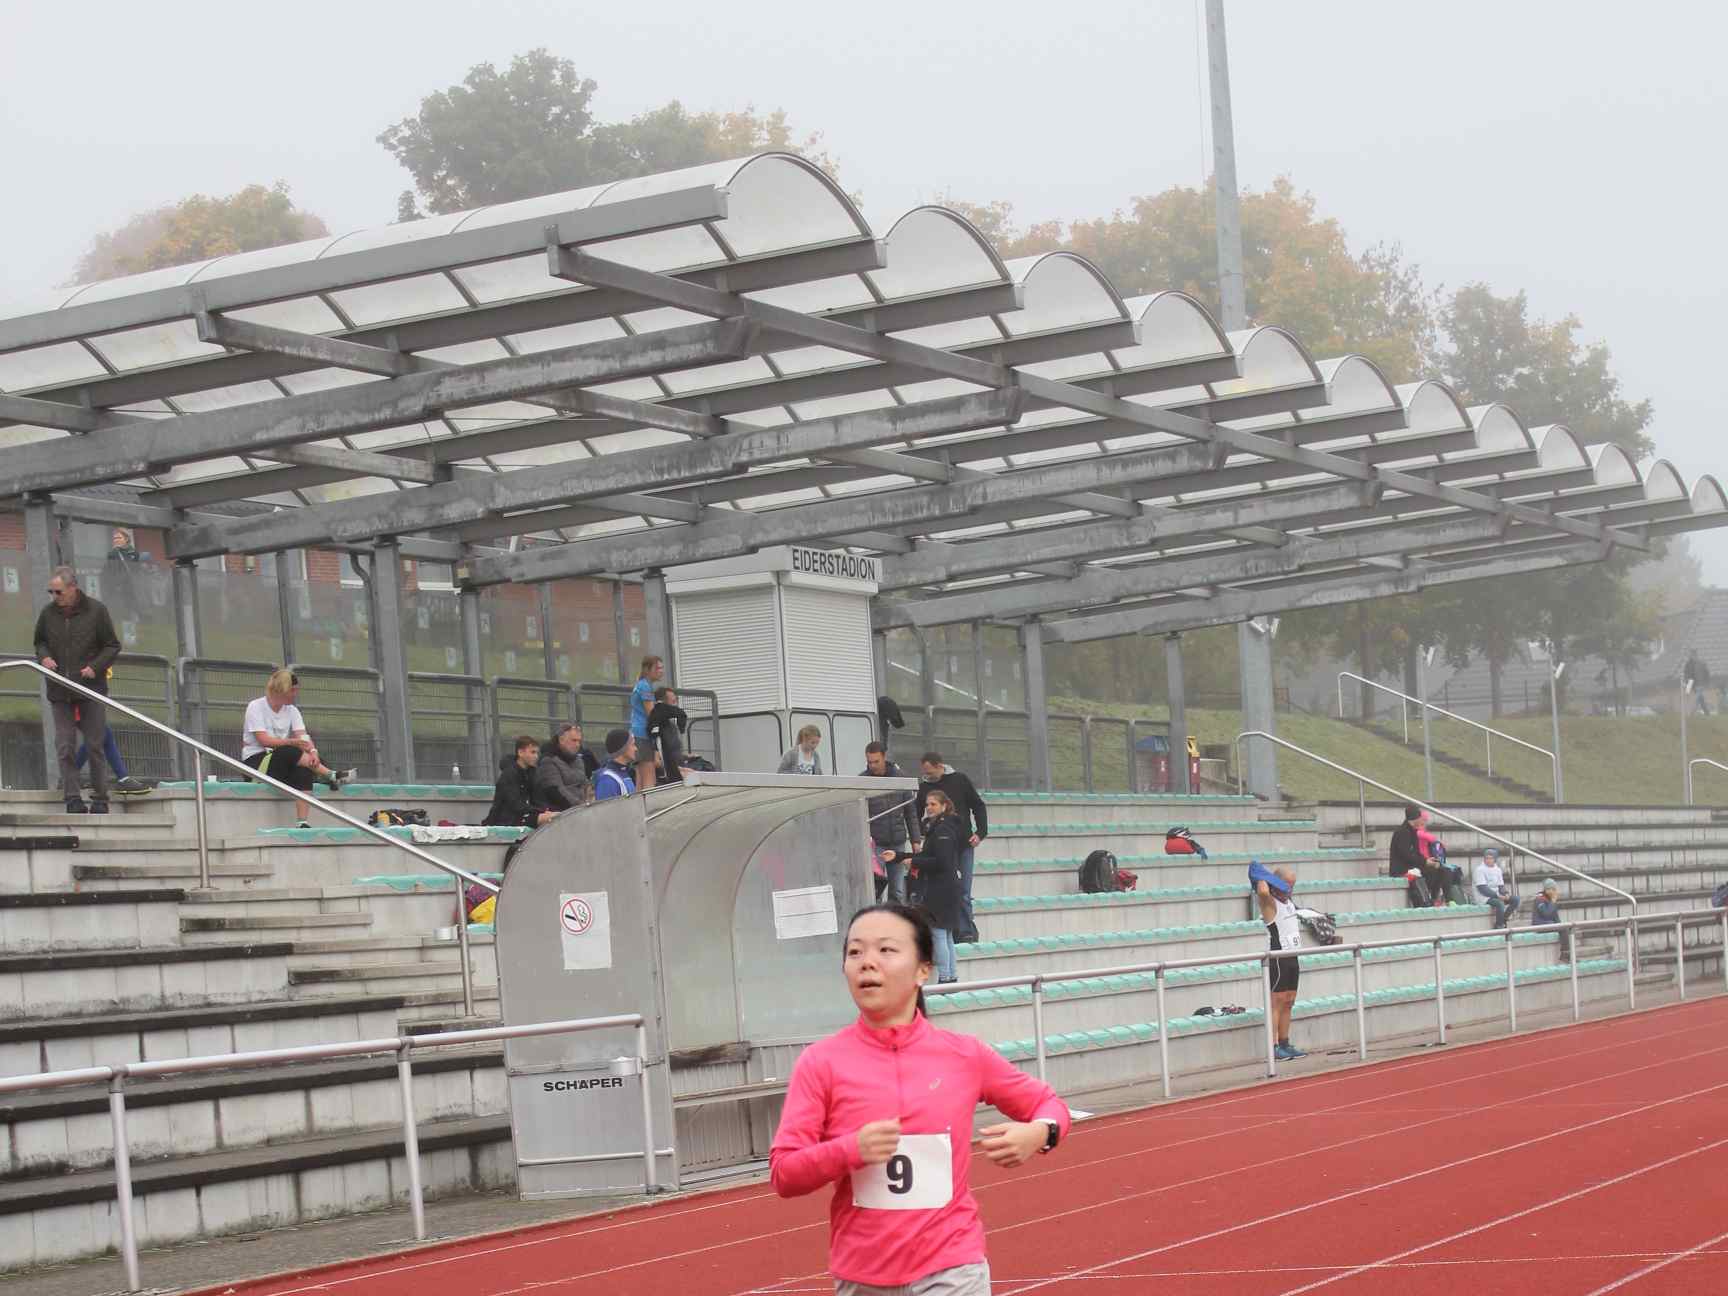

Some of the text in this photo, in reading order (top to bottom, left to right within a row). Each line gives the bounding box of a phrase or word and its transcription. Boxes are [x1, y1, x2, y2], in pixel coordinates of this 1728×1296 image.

[792, 548, 875, 580] EIDERSTADION
[543, 1077, 623, 1092] SCHÄPER
[886, 1154, 913, 1195] 9
